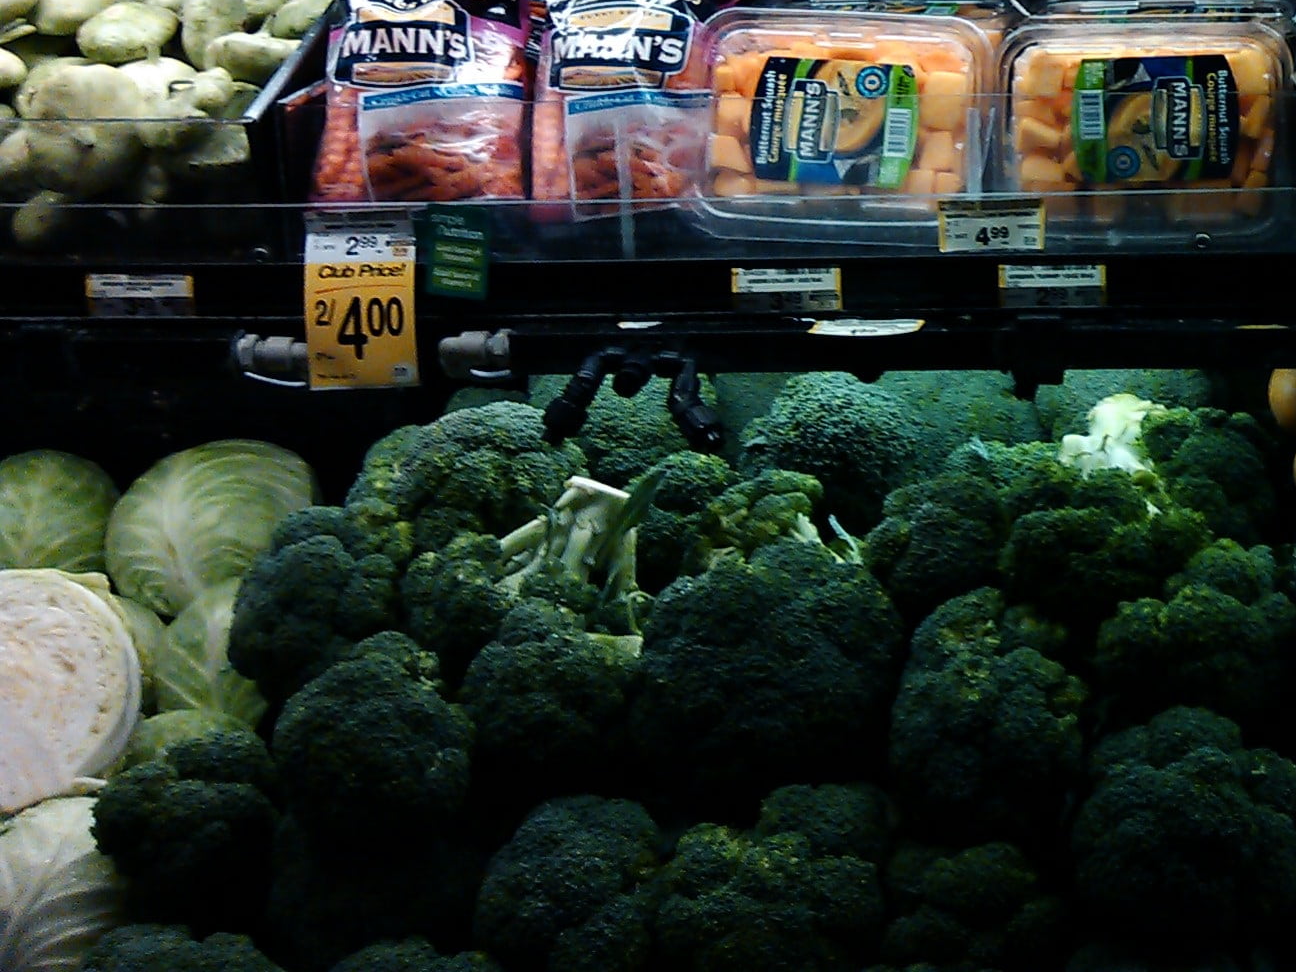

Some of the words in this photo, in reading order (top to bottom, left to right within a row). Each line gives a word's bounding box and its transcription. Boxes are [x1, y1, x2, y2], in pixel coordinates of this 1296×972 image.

[342, 27, 469, 59] MANN'S
[1217, 69, 1229, 123] Butternut
[756, 112, 772, 165] Butternut
[764, 70, 777, 109] Squash
[801, 83, 822, 157] MANN'S
[1172, 82, 1188, 156] MANN'S
[1219, 126, 1229, 164] Squash
[345, 236, 378, 255] 299
[975, 226, 1010, 246] 499
[318, 265, 355, 279] Club
